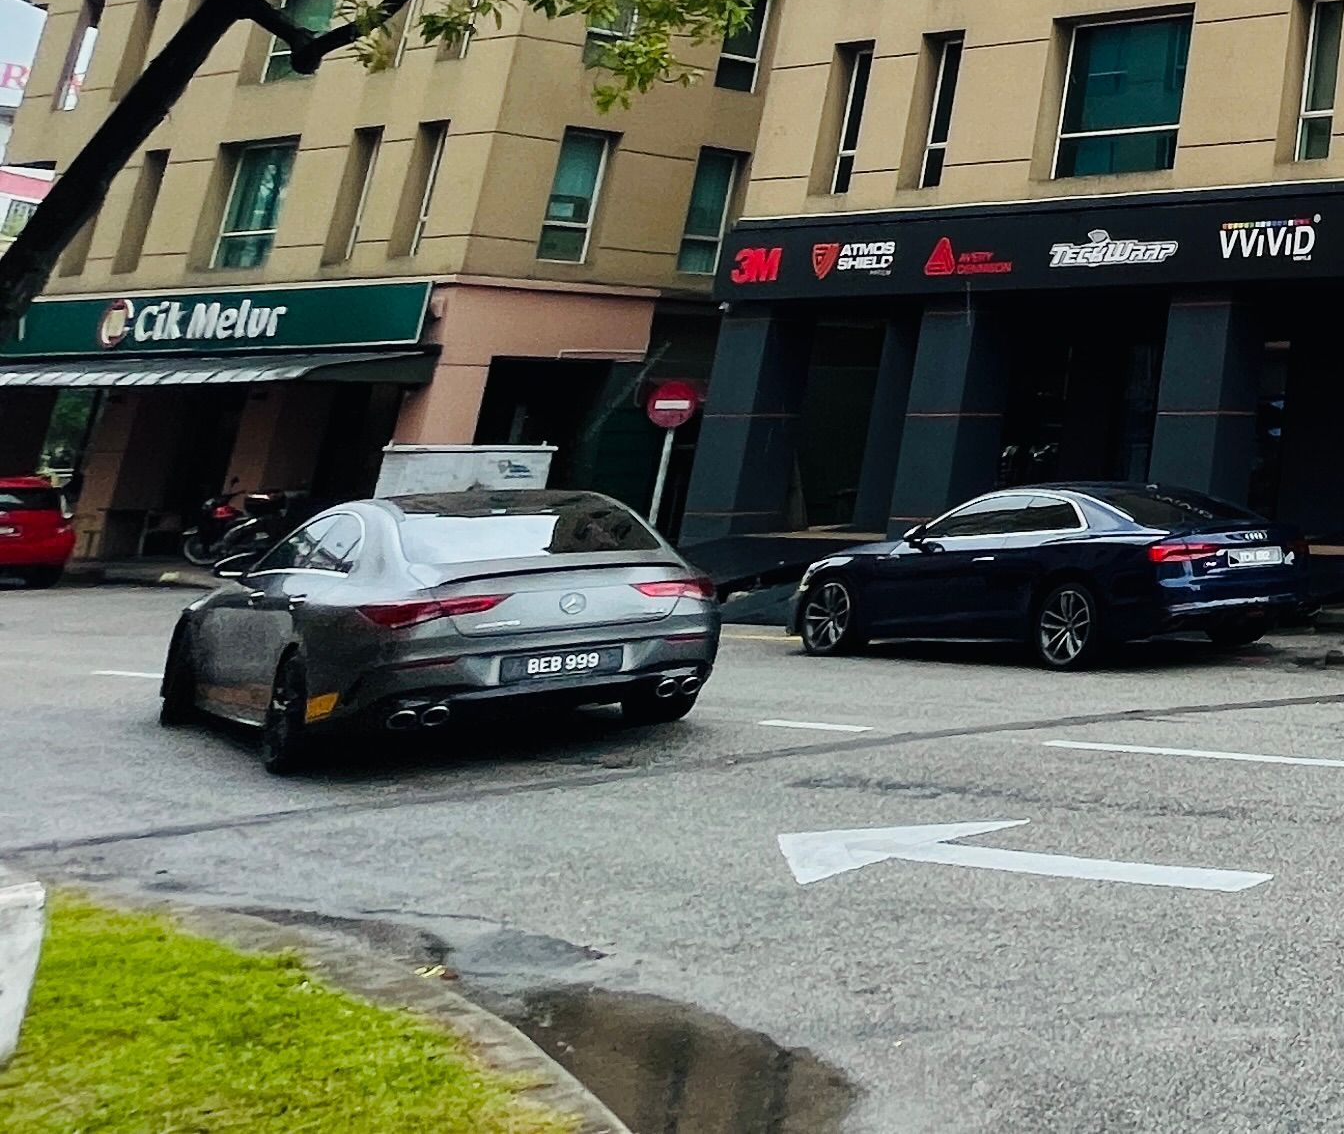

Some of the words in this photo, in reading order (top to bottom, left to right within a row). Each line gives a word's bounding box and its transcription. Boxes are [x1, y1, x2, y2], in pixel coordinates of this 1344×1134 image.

[839, 241, 896, 257] ATMOS
[730, 247, 784, 285] 3M
[837, 255, 894, 271] SHIELD
[134, 300, 188, 343] Cik
[186, 298, 288, 340] Melur
[526, 656, 562, 674] BEB
[565, 651, 600, 671] 999
